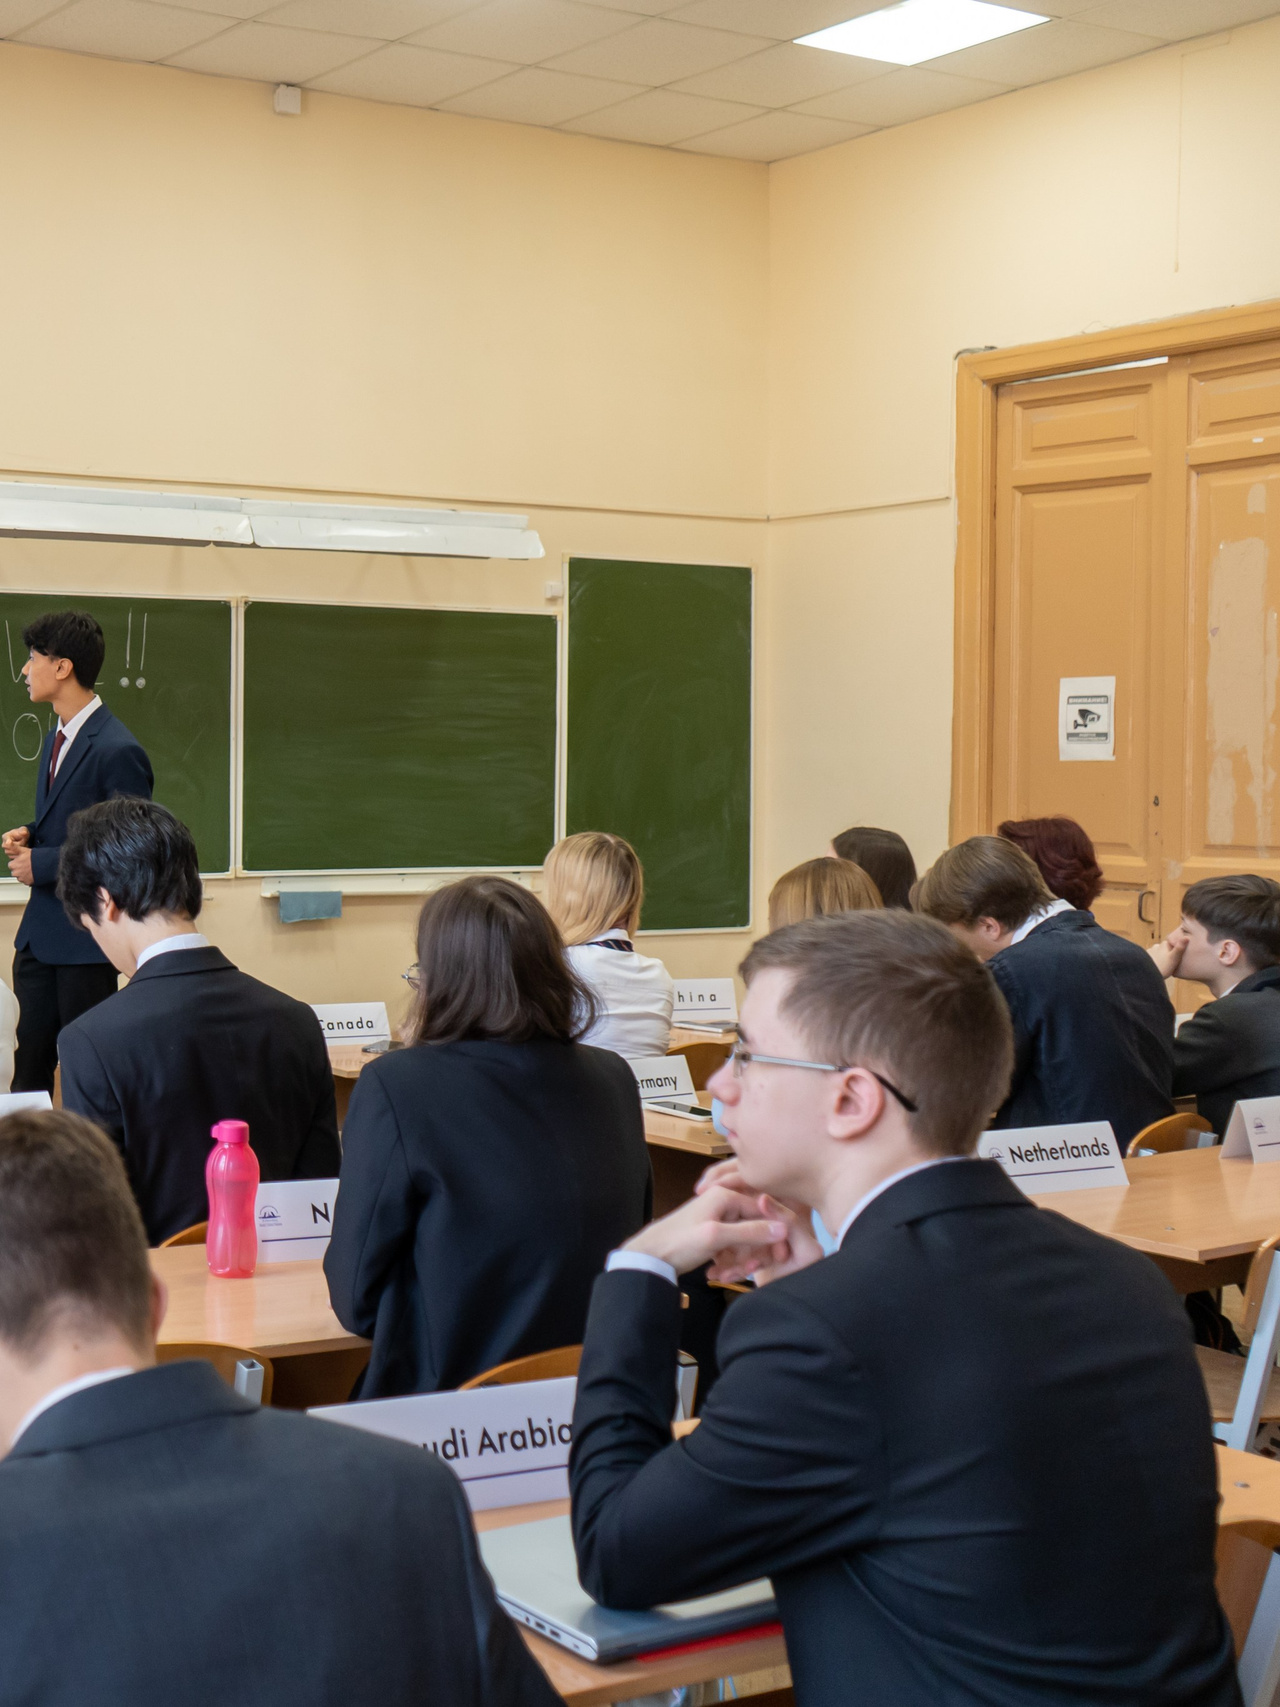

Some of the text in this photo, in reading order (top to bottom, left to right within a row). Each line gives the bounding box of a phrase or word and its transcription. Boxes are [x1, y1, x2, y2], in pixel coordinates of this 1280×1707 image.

[678, 991, 717, 1002] hina
[637, 1076, 677, 1090] rmany
[1008, 1137, 1110, 1164] Netherlands
